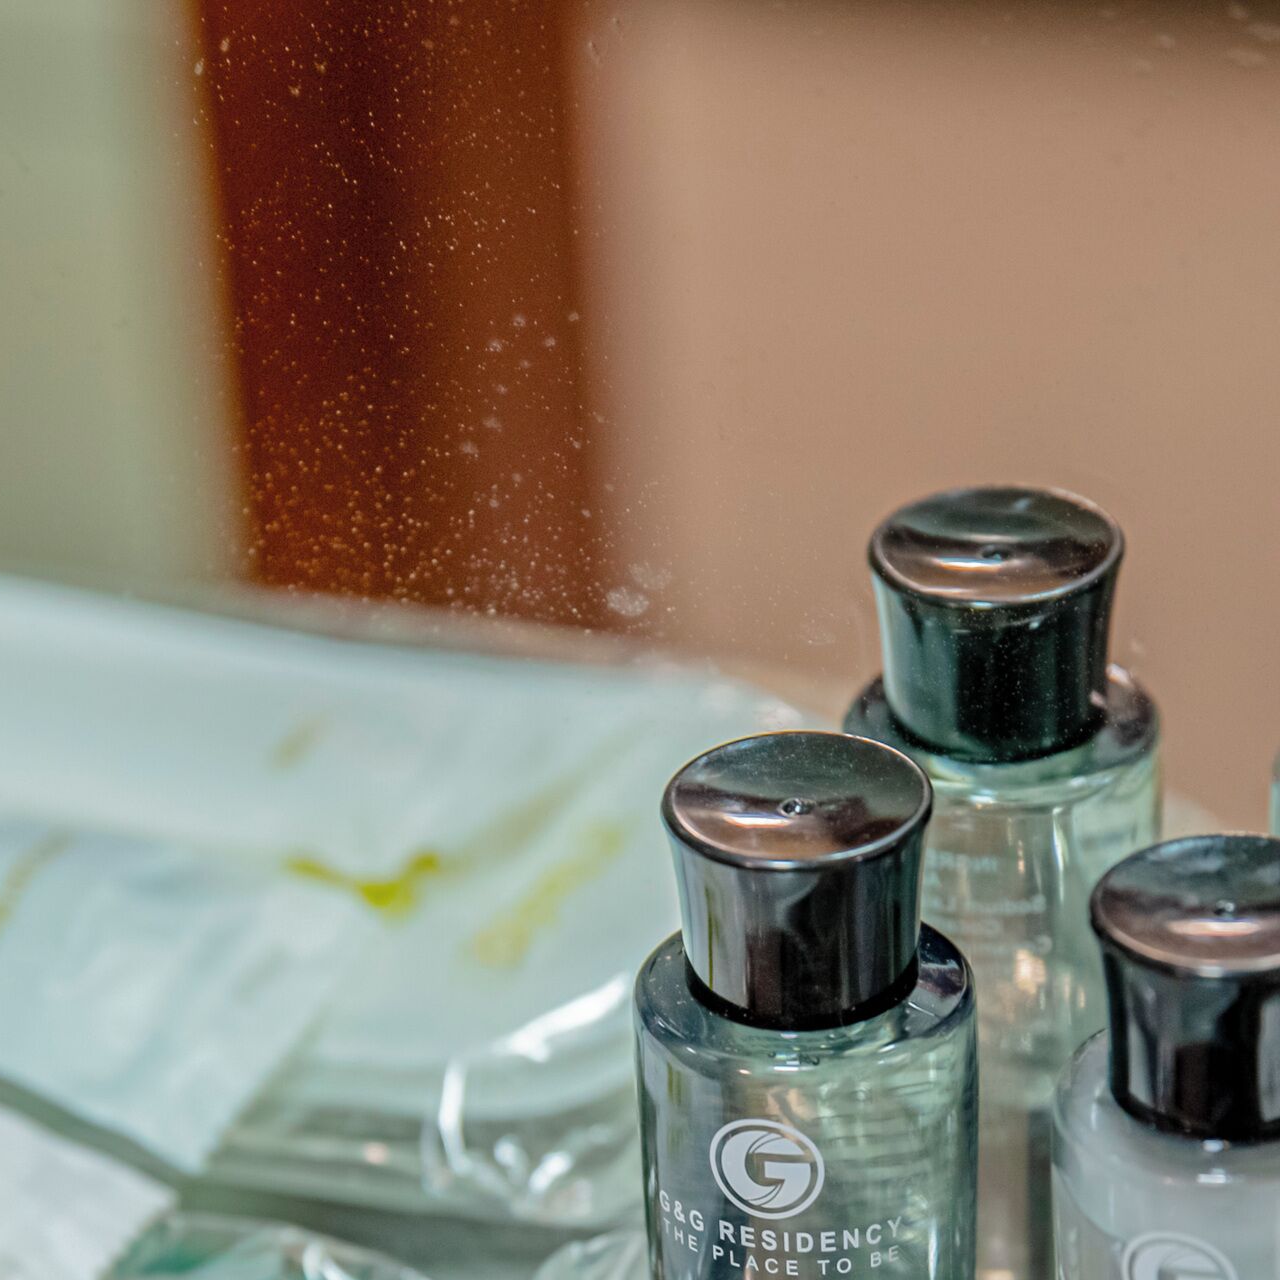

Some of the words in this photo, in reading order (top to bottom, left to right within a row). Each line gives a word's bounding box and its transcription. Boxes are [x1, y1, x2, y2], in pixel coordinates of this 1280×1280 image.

[716, 1125, 818, 1214] G
[659, 1190, 705, 1232] G&G
[719, 1217, 901, 1253] RESIDENCY
[662, 1217, 699, 1252] THE
[712, 1245, 799, 1276] PLACE
[818, 1257, 852, 1275] TO
[870, 1245, 900, 1268] BE
